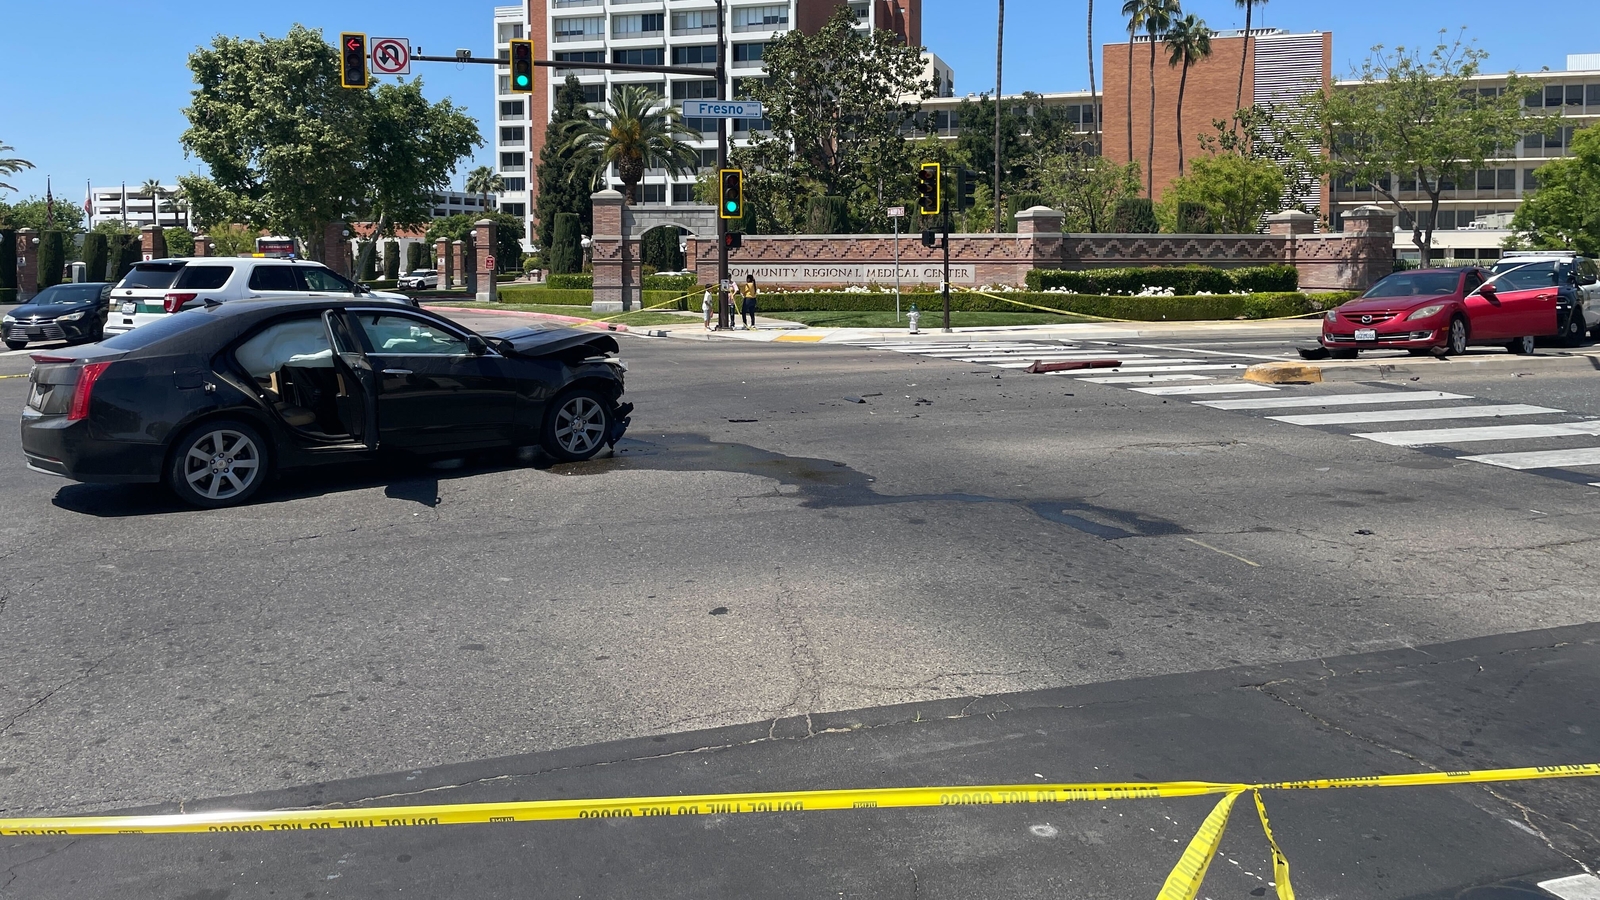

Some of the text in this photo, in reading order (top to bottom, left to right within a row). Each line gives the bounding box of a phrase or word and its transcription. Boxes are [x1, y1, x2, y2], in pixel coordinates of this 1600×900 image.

[699, 103, 744, 115] Fresno
[803, 268, 862, 278] REGIONAL
[866, 268, 919, 278] MEDICAL
[923, 268, 969, 278] CENTER
